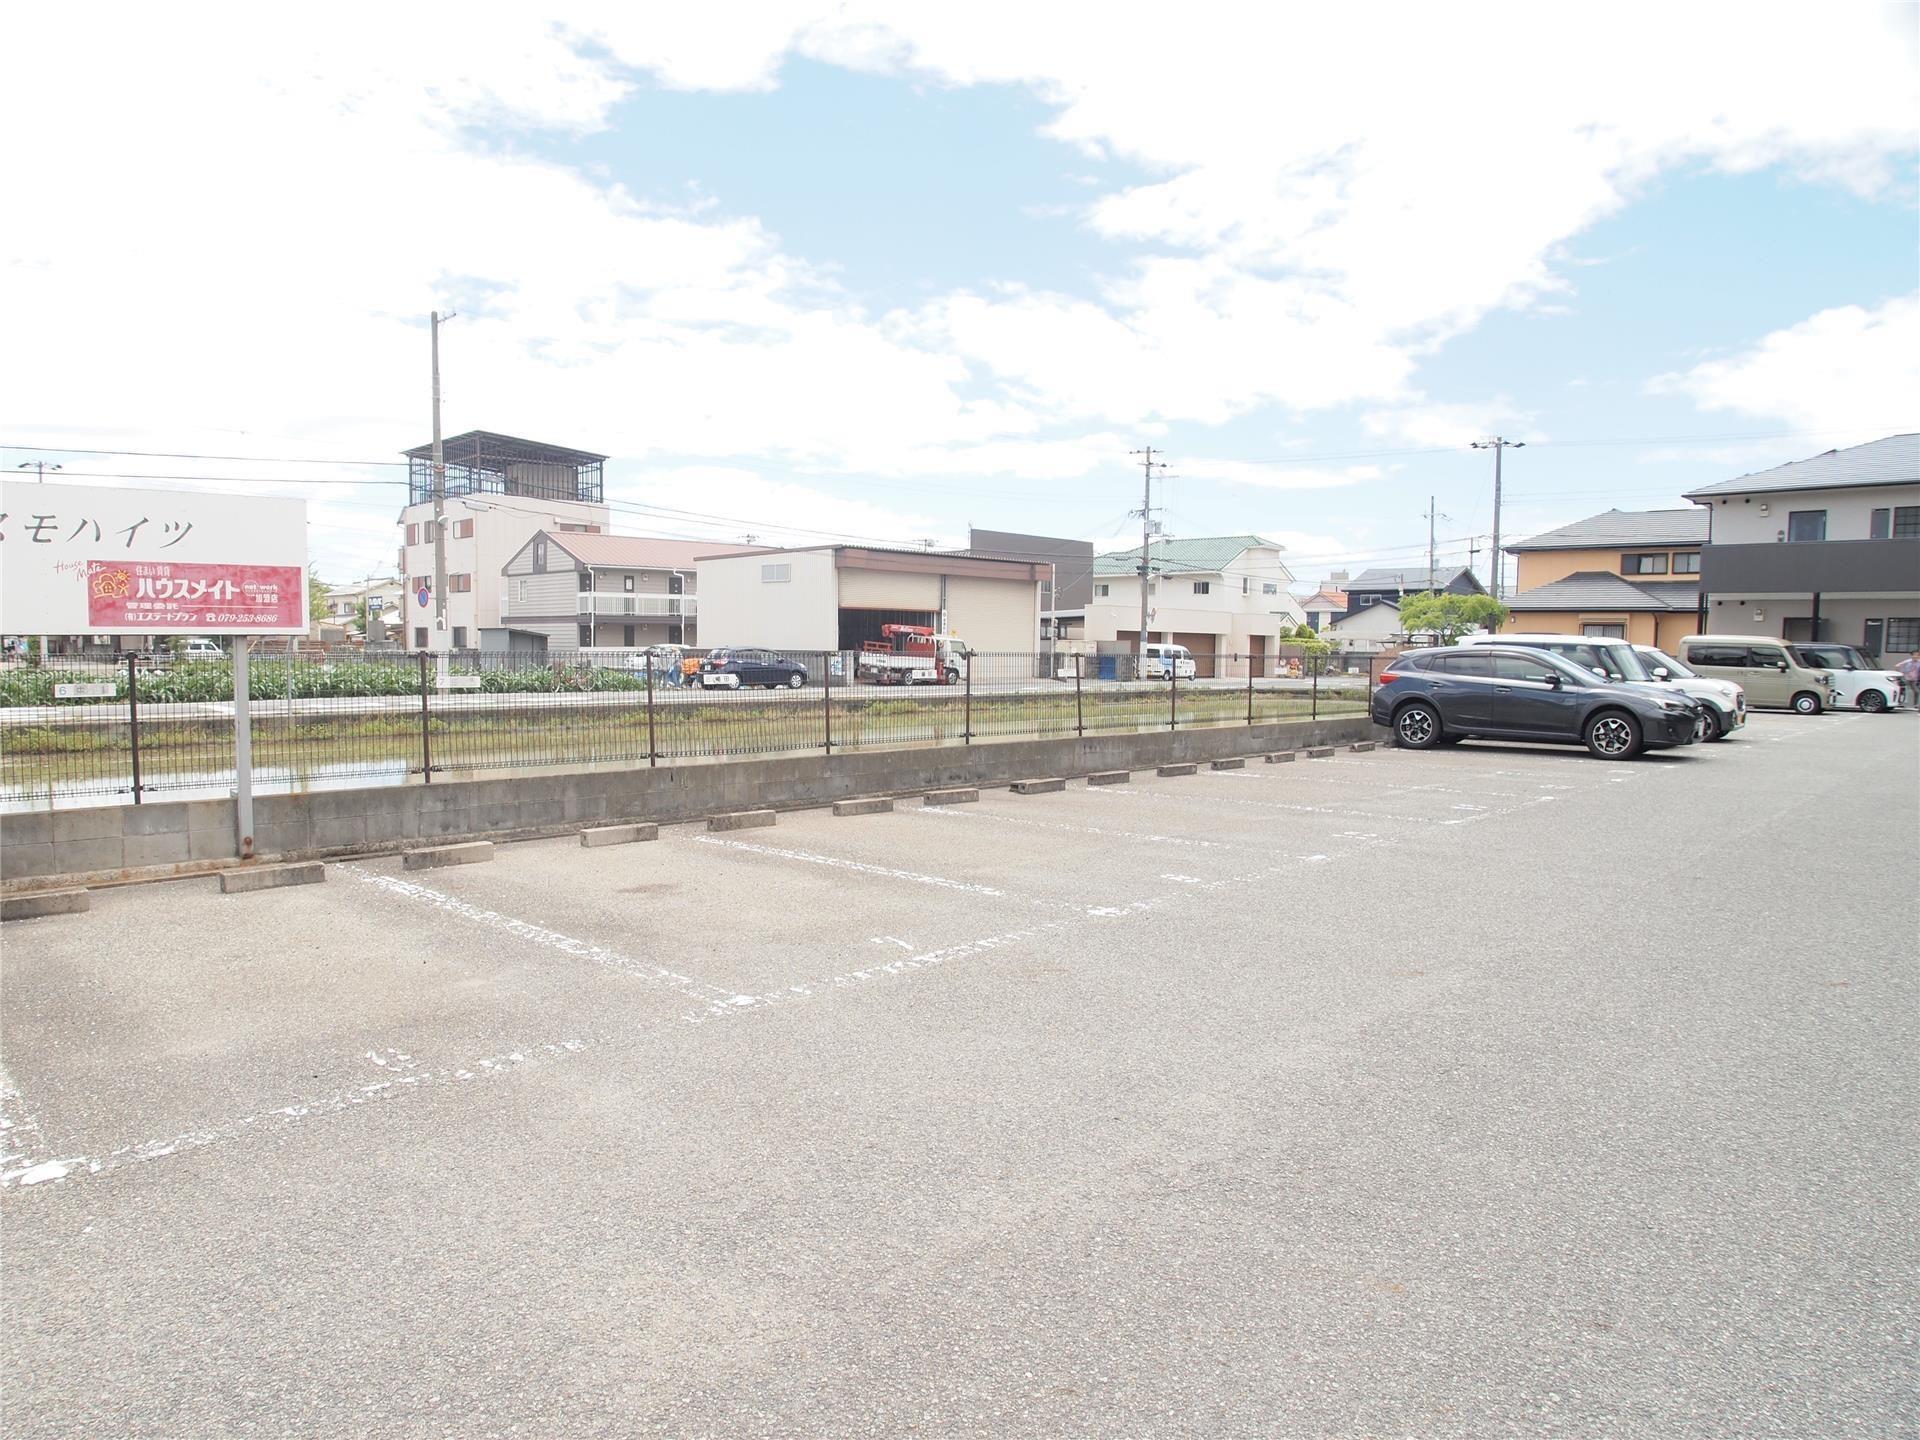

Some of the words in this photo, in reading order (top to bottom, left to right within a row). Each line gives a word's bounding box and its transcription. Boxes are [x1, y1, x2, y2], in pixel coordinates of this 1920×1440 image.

[53, 559, 84, 574] House
[76, 561, 107, 582] Mate
[136, 577, 240, 600] ハウスメイト
[59, 686, 67, 696] 6
